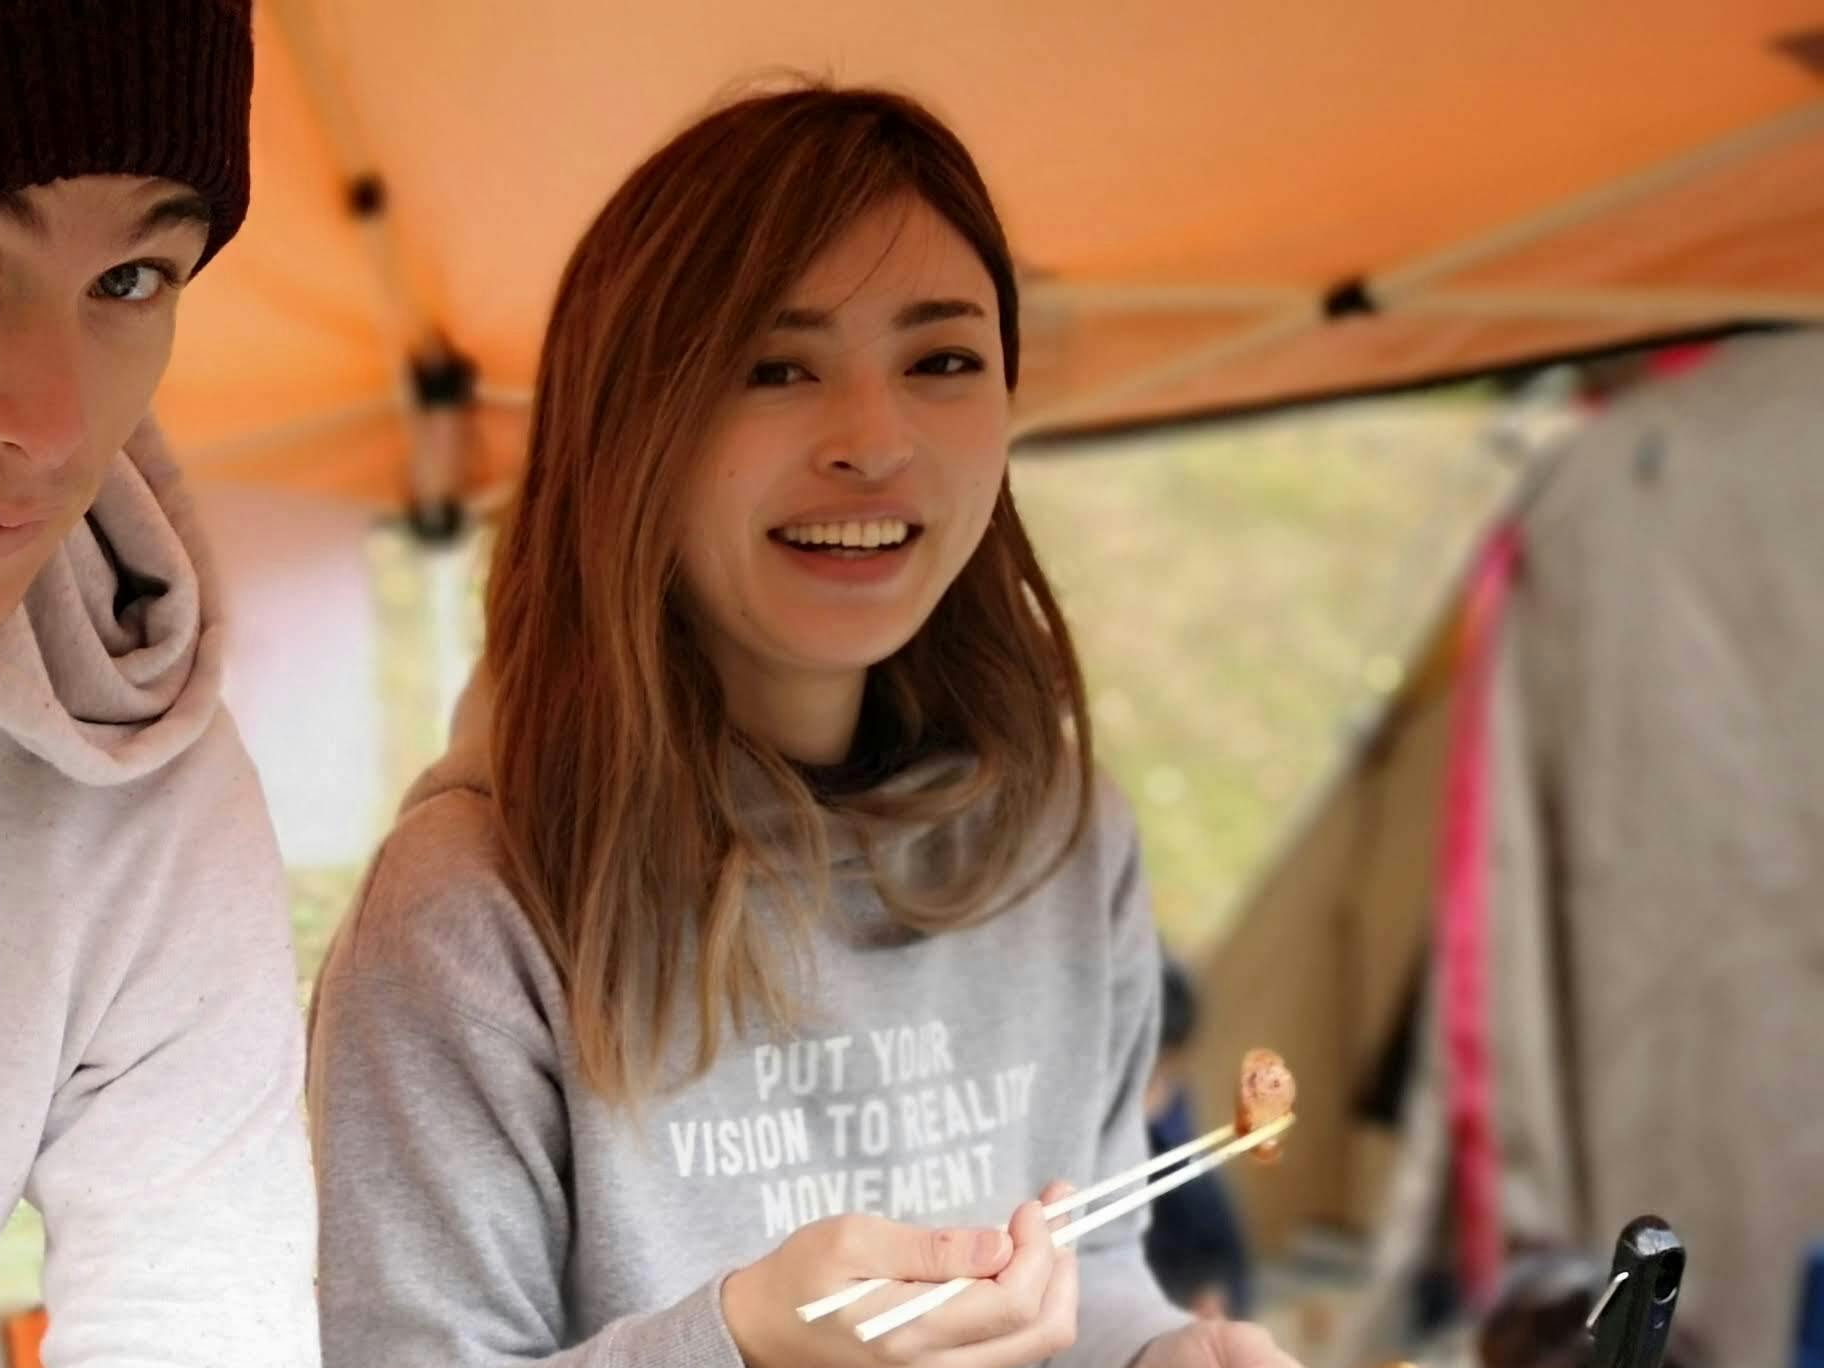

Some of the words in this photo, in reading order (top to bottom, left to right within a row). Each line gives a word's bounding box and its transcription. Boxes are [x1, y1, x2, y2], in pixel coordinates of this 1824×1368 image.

[754, 1035, 853, 1101] PUT
[870, 1020, 954, 1086] YOUR
[669, 1107, 809, 1177] VISION
[827, 1101, 889, 1158] TO
[760, 1143, 993, 1239] MOVEMENT
